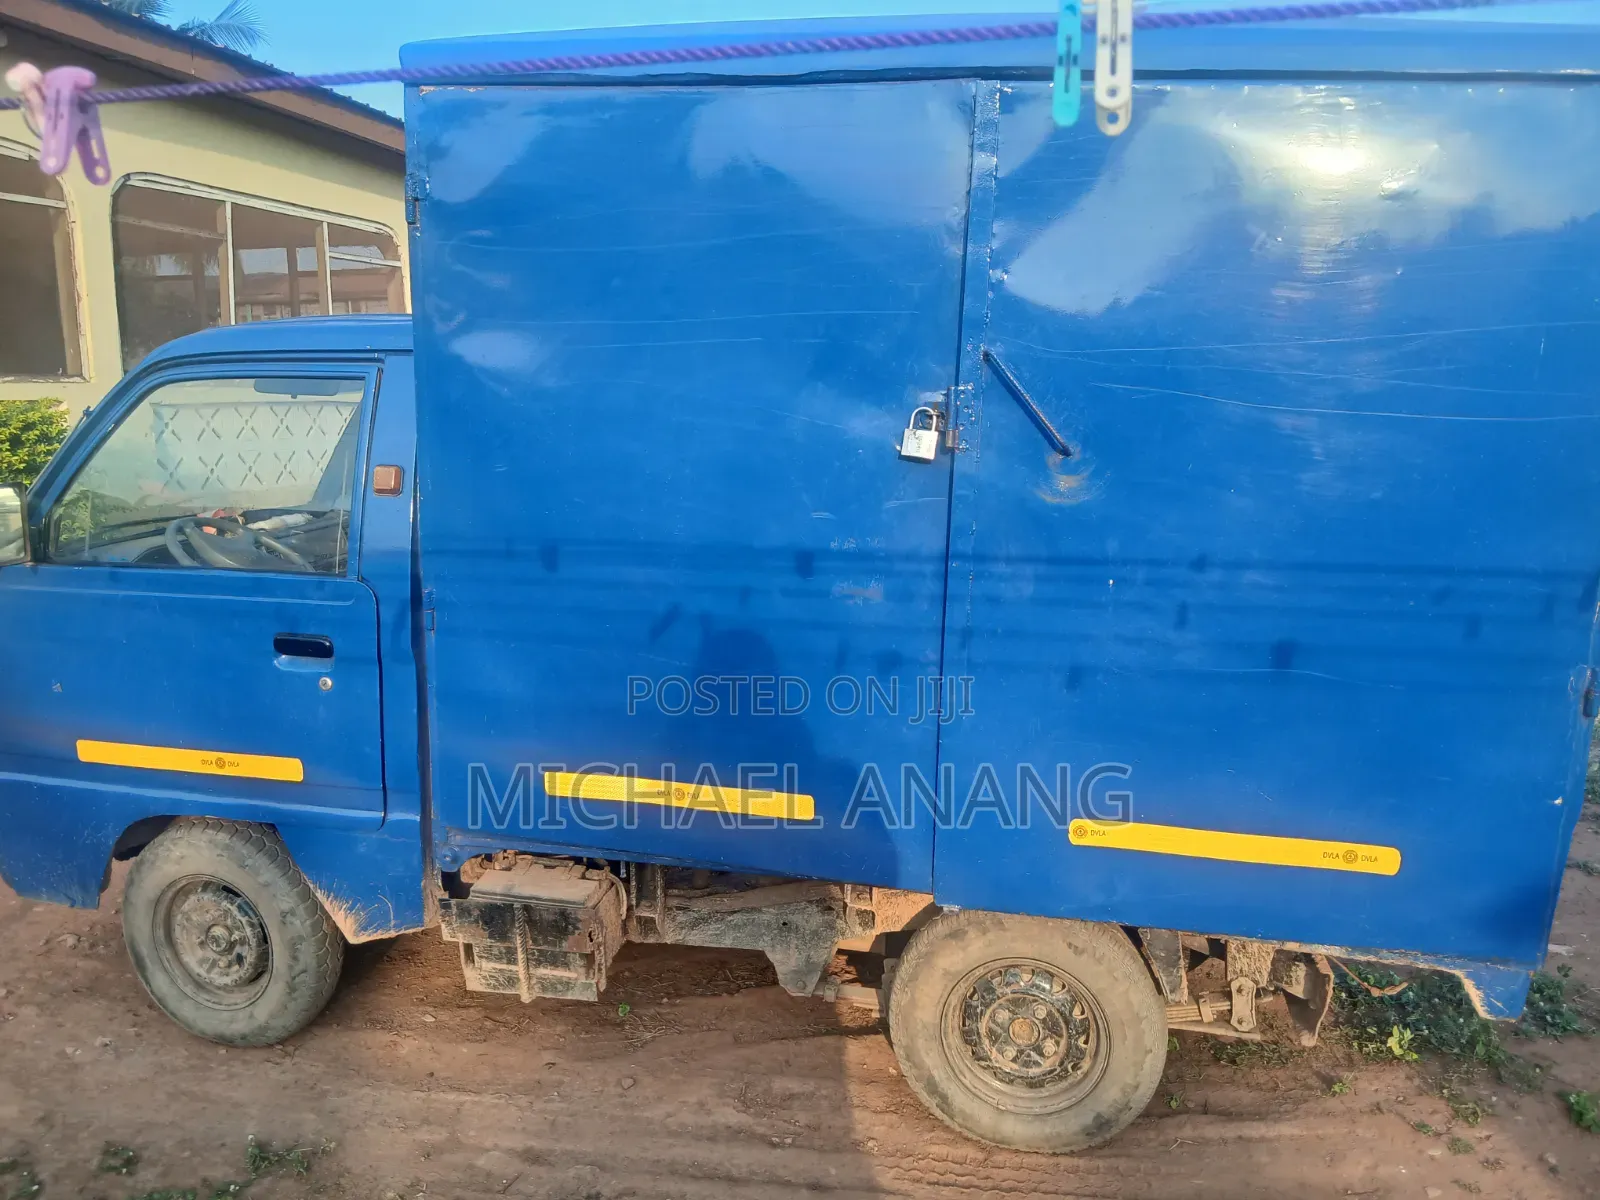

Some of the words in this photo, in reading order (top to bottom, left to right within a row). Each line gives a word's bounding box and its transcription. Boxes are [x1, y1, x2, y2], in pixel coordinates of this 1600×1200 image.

[1090, 829, 1107, 837] DVLA
[1322, 851, 1340, 860] DVLA
[1360, 854, 1379, 863] DVLA
